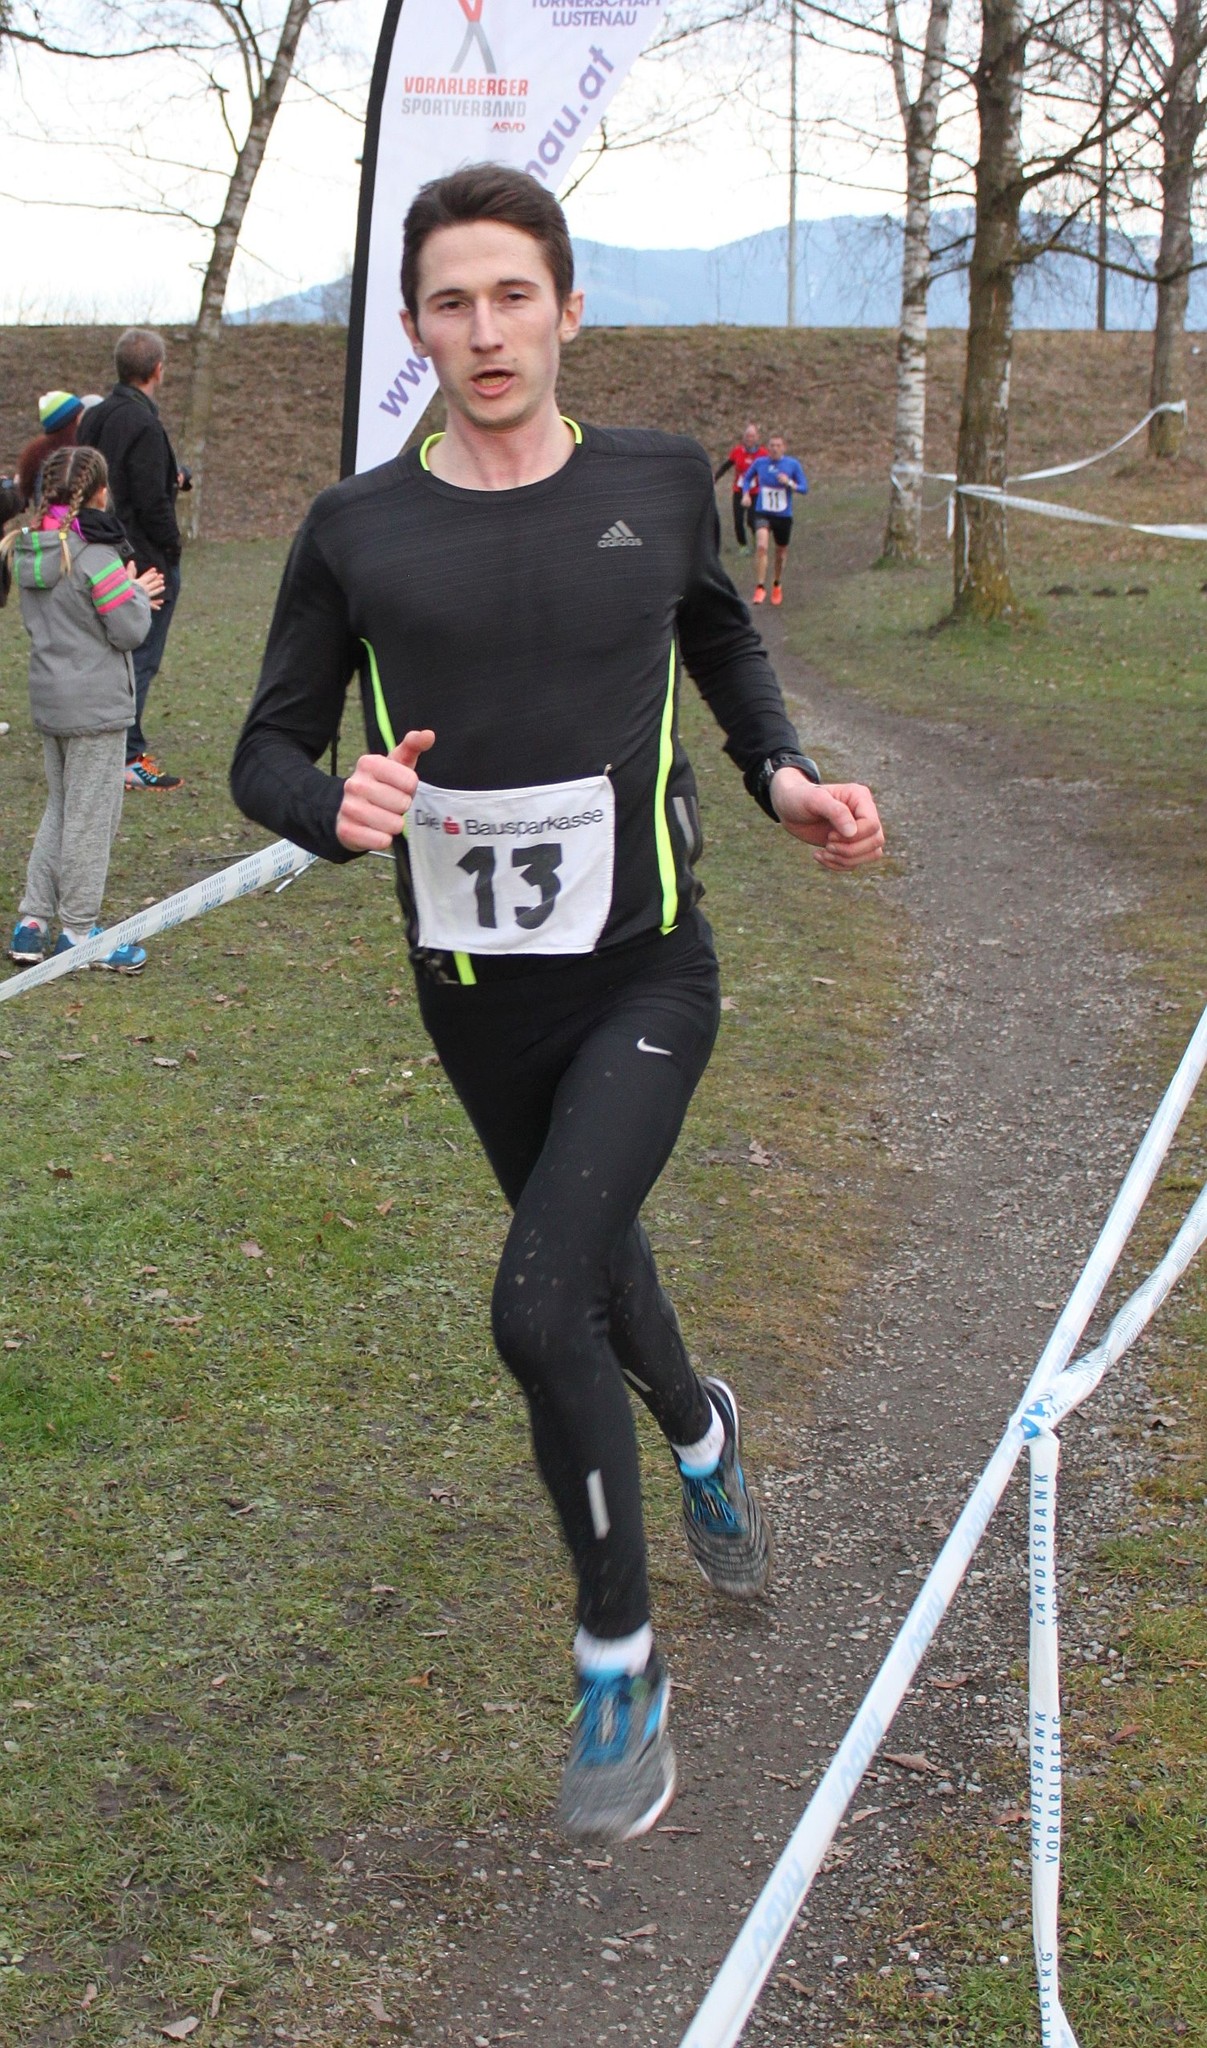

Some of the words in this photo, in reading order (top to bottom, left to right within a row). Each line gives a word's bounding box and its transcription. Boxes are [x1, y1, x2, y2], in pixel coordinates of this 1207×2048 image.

[552, 10, 638, 27] LUSTENAU
[404, 76, 529, 97] VORARLBERGER
[401, 98, 527, 118] SPORTVERBAND
[379, 357, 429, 418] ww
[524, 44, 615, 181] nau.at
[768, 491, 780, 509] 11
[597, 537, 643, 548] adidas
[415, 809, 441, 830] Die
[464, 808, 604, 838] Bausparkasse
[456, 843, 563, 930] 13
[1033, 1473, 1049, 1626] LANDESBANK
